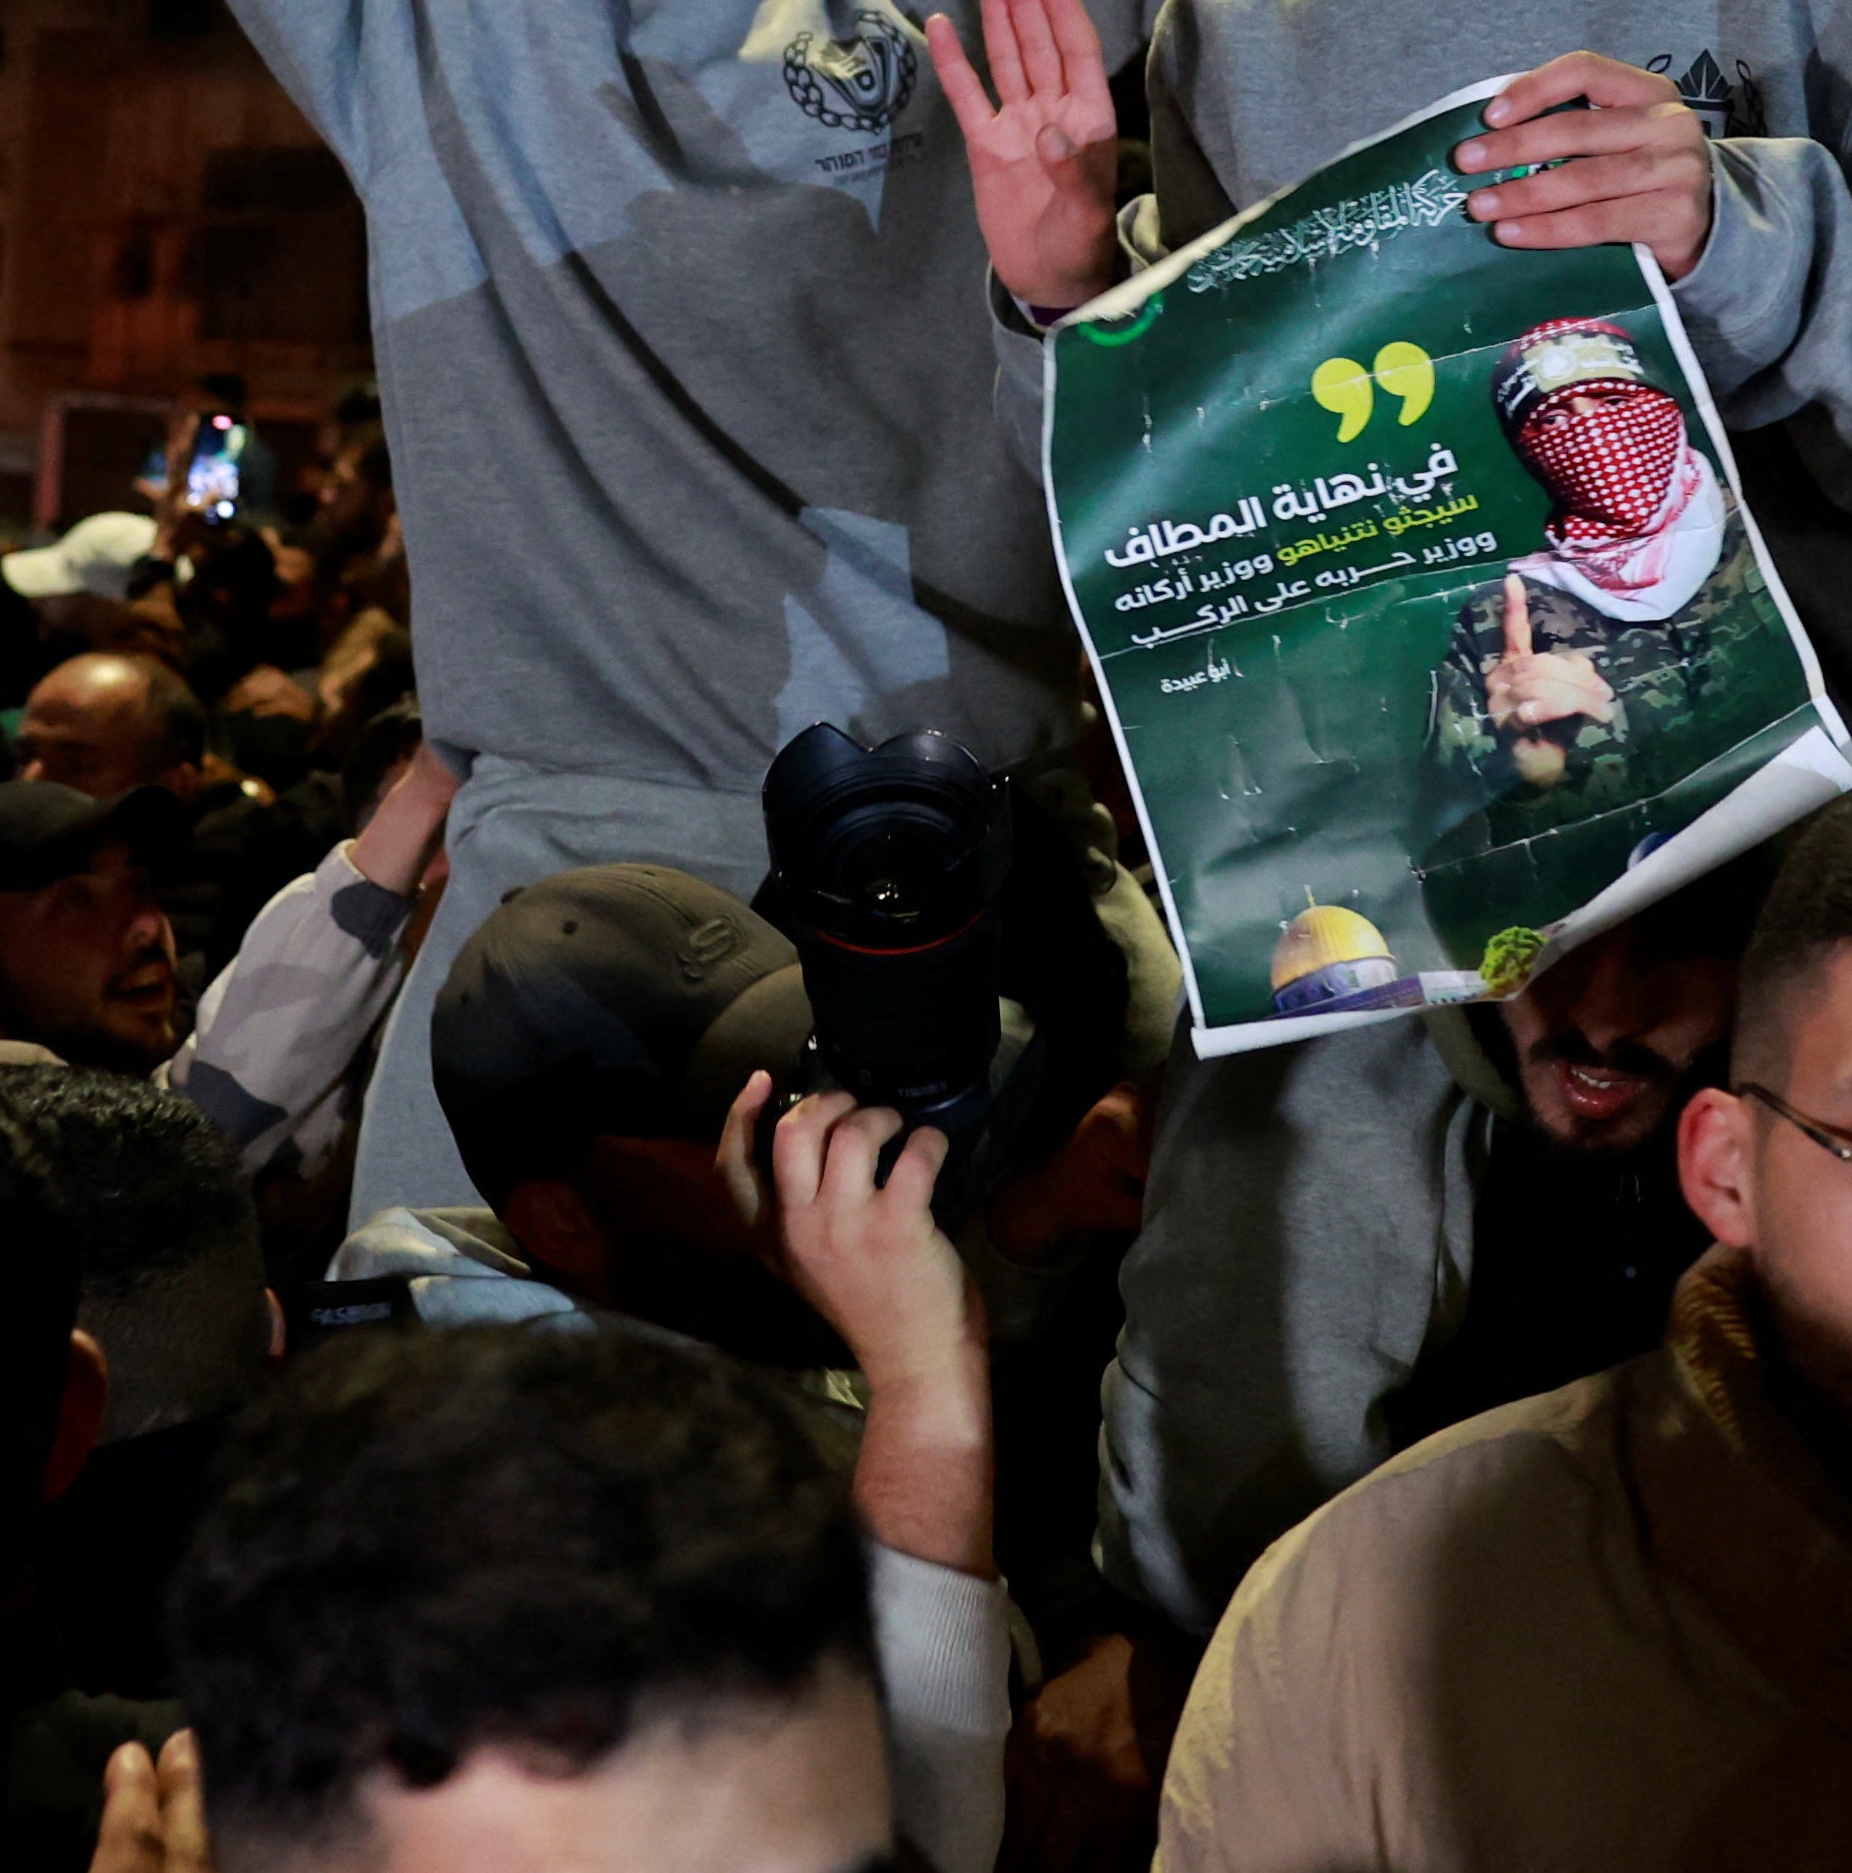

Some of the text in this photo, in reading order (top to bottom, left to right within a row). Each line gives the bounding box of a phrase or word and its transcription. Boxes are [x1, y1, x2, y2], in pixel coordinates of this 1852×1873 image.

[1104, 442, 1459, 568] في نهاية المطاف
[1114, 493, 1480, 614] سيجثو نتنياهو ووزير أركانه
[1422, 530, 1499, 565] ووزير
[1253, 578, 1312, 613] على
[1160, 671, 1208, 694] عبيدة
